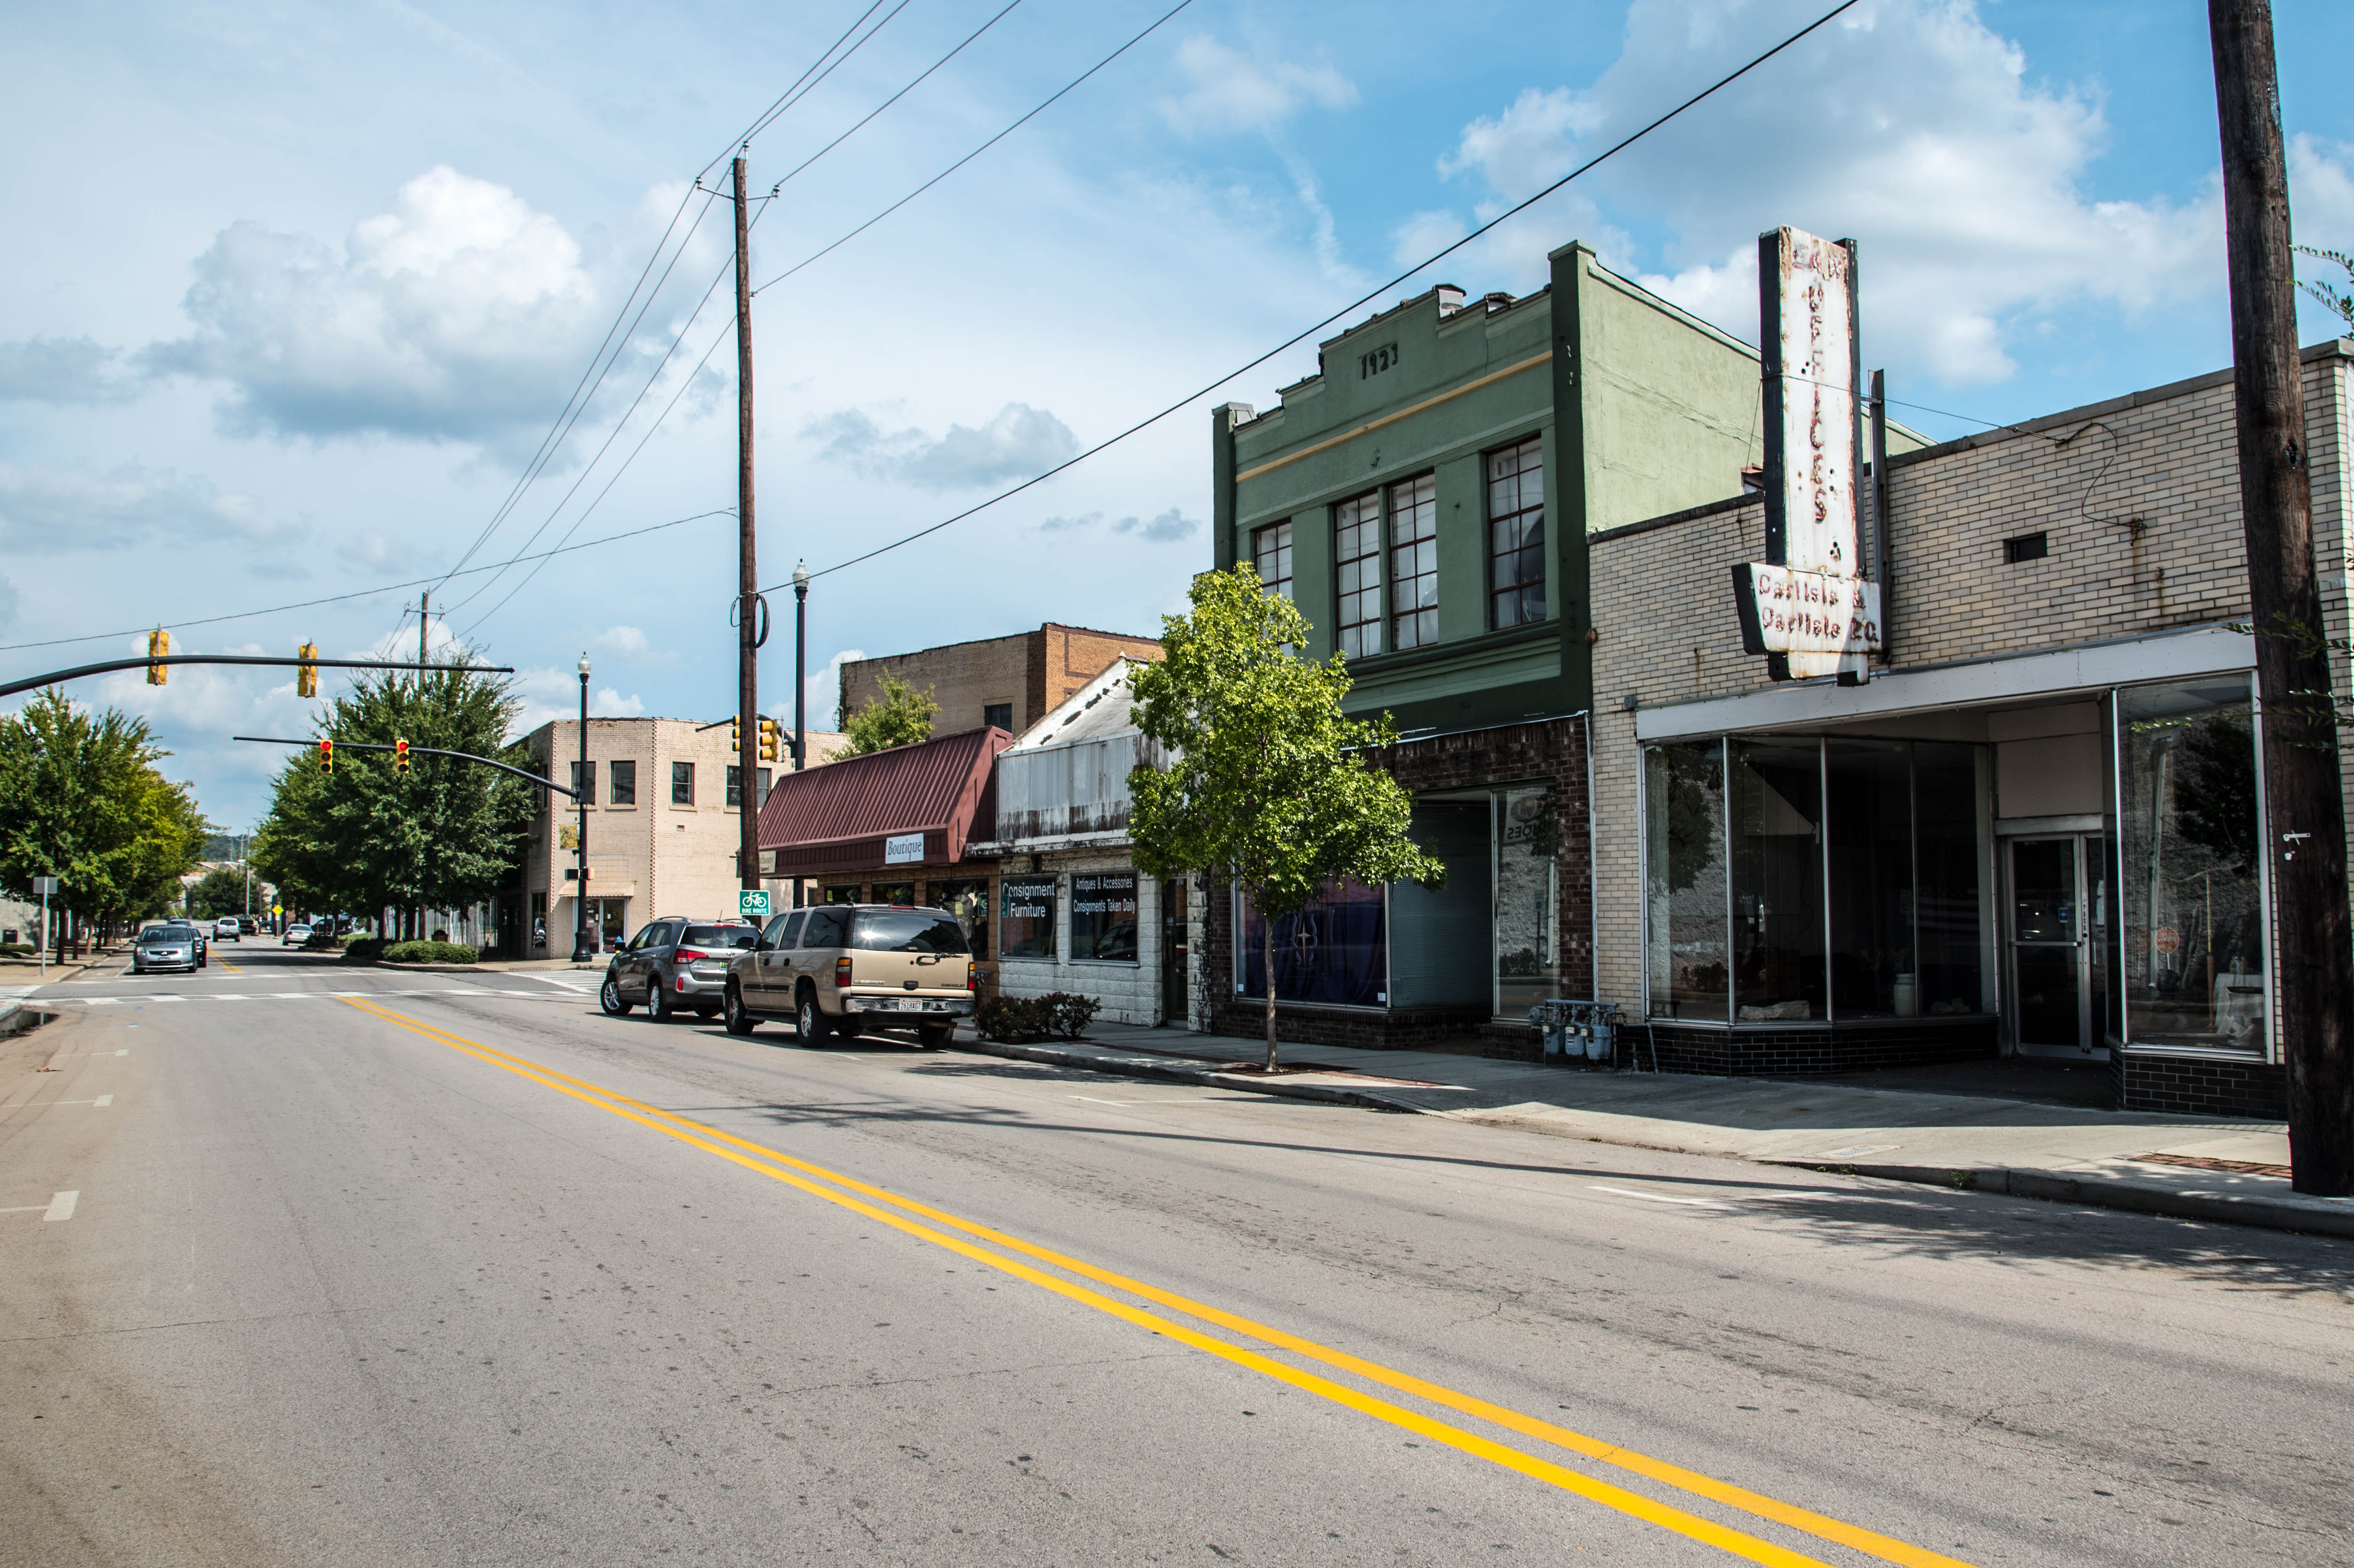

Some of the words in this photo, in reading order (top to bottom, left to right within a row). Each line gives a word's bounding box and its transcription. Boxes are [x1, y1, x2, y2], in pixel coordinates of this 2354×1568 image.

[1361, 343, 1398, 380] 1923
[1759, 574, 1839, 605] Carlisle
[1853, 590, 1866, 608] &
[1763, 607, 1840, 638] Carlisle
[887, 838, 922, 861] Boutique
[760, 854, 774, 867] thony
[1003, 882, 1055, 900] Consignment
[1076, 877, 1096, 892] Antiques
[1098, 876, 1101, 889] &
[1103, 875, 1133, 889] Accessories
[1011, 902, 1046, 917] Furniture
[1074, 899, 1106, 915] Consignments
[1107, 899, 1122, 911] Taken
[1123, 898, 1135, 914] Daily
